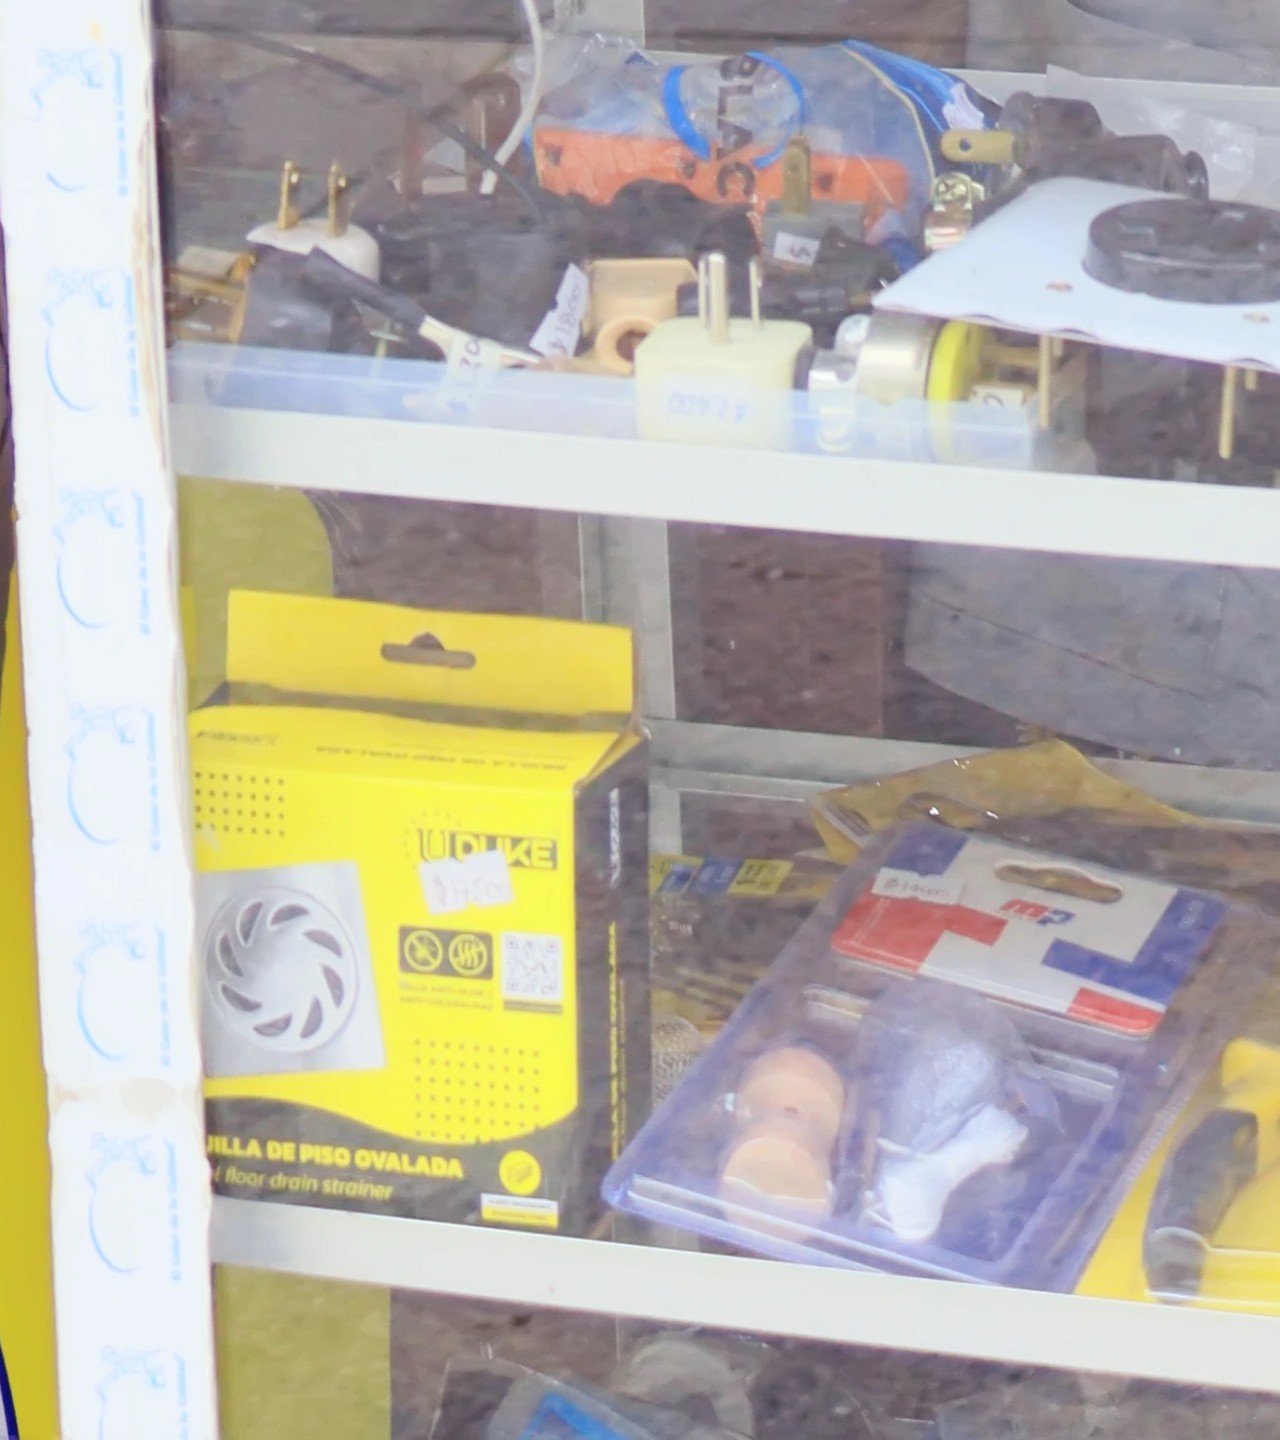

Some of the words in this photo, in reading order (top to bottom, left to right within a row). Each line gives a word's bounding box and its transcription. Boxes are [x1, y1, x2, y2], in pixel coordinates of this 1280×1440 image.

[267, 1139, 295, 1162] DE
[299, 1144, 350, 1169] PISO
[354, 1147, 464, 1179] OVALADA
[225, 1167, 265, 1187] floor
[269, 1170, 319, 1192] drain
[322, 1176, 395, 1200] strainer
